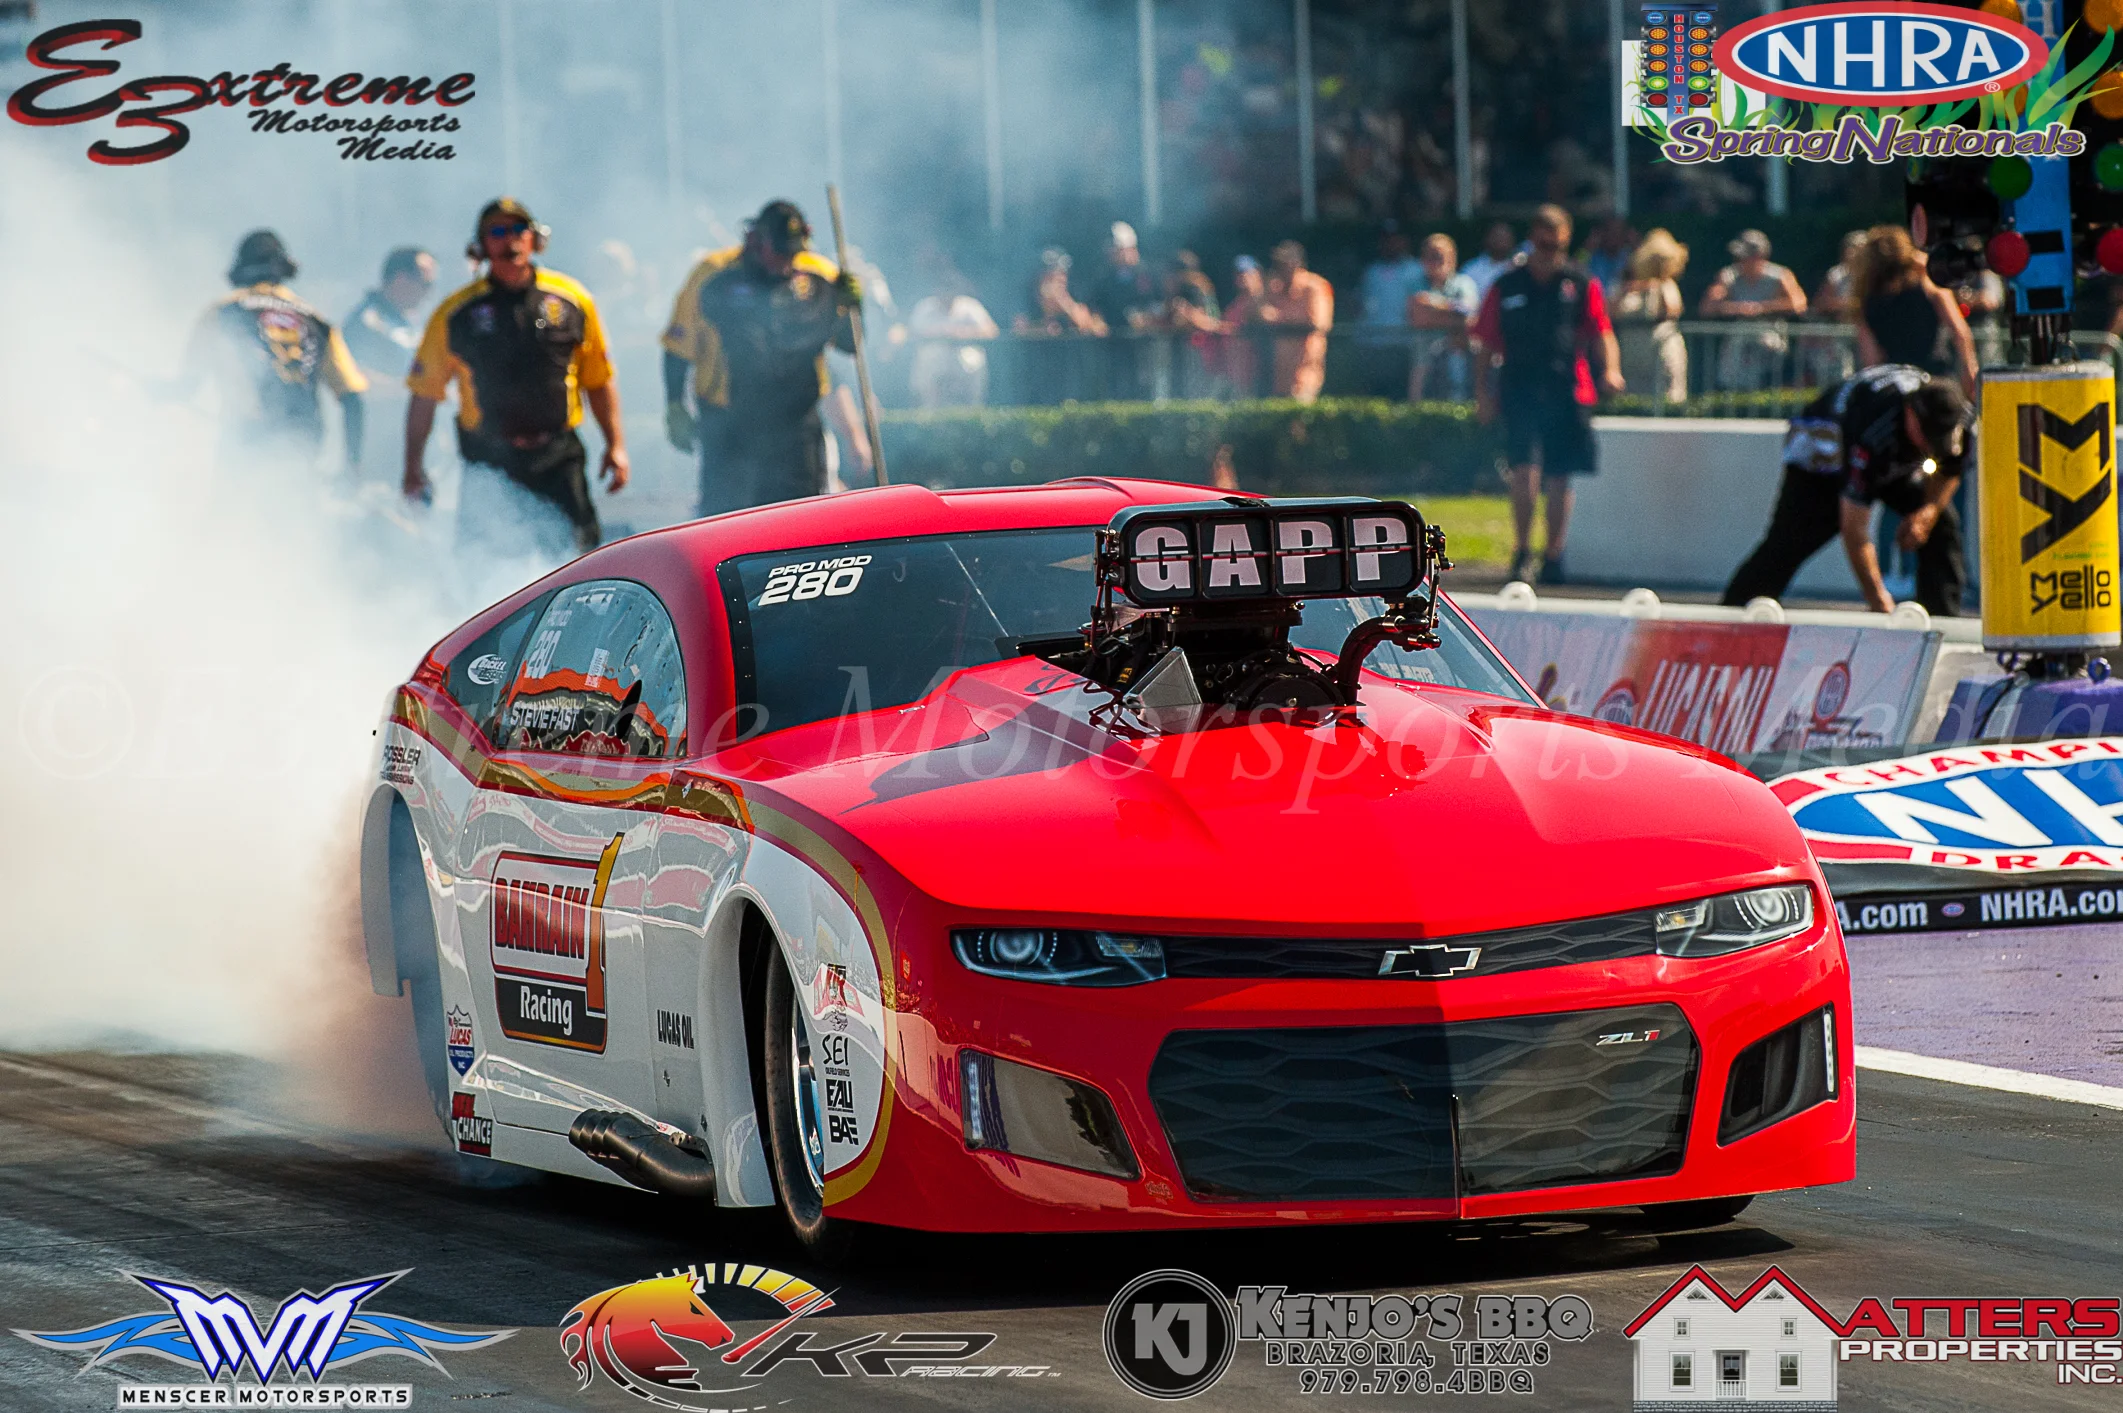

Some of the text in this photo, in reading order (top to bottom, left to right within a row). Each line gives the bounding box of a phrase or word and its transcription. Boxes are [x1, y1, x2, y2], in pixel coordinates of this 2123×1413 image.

[768, 554, 873, 579] PRO MOD
[1134, 516, 1409, 592] GAPP
[757, 566, 864, 607] 280
[1931, 850, 2123, 870] DRA
[494, 876, 590, 960] BAHRAIN
[520, 985, 573, 1036] Racing
[449, 1028, 472, 1045] LUCAS
[657, 1008, 695, 1049] LUCAS OIL
[1595, 1029, 1661, 1046] ZL1
[821, 1034, 849, 1066] SEI
[457, 1116, 492, 1145] CHANCE
